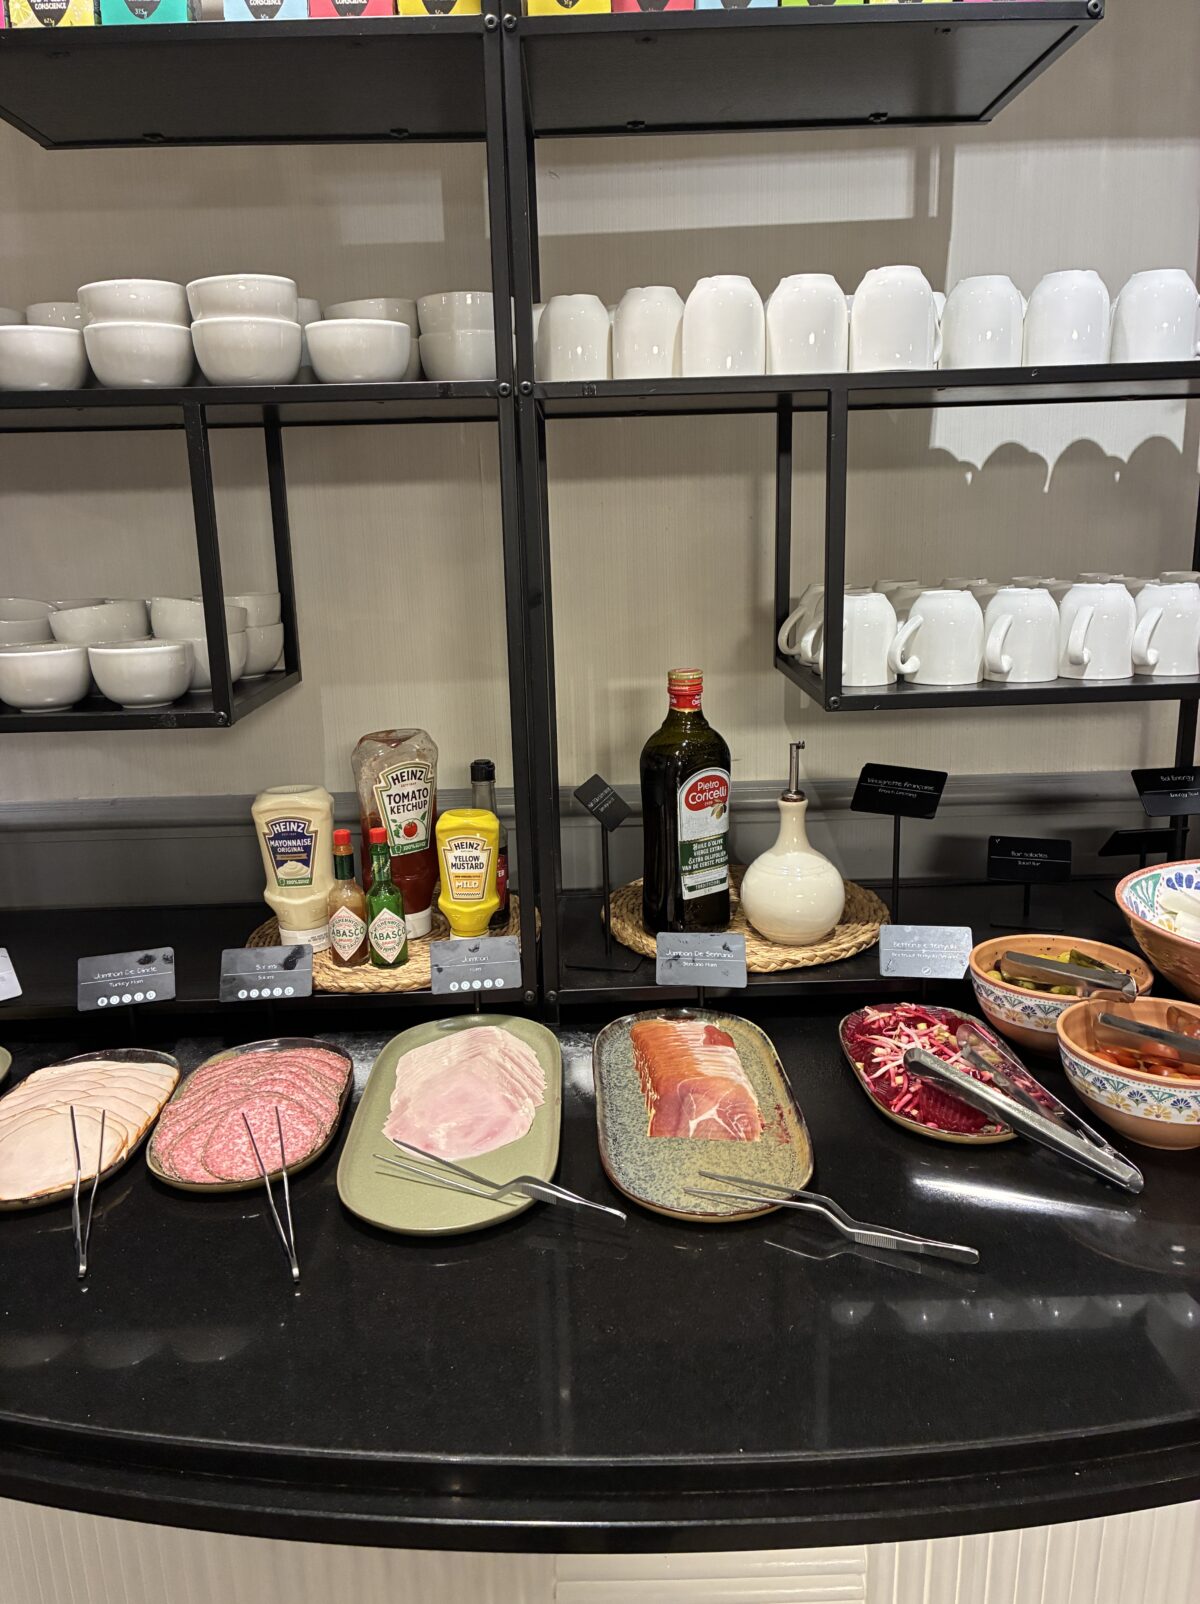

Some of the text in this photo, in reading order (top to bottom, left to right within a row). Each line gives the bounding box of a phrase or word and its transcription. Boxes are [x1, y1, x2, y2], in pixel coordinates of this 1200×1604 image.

[391, 770, 424, 786] HEINZ
[698, 780, 720, 791] Pietro
[387, 788, 428, 805] TOMATO
[688, 786, 726, 804] Coricelli
[390, 800, 428, 815] KETCHUP
[272, 821, 304, 834] HEINZ
[270, 838, 312, 848] MAYONNAISE
[454, 842, 480, 851] HEINZ
[330, 926, 364, 938] ABASCO
